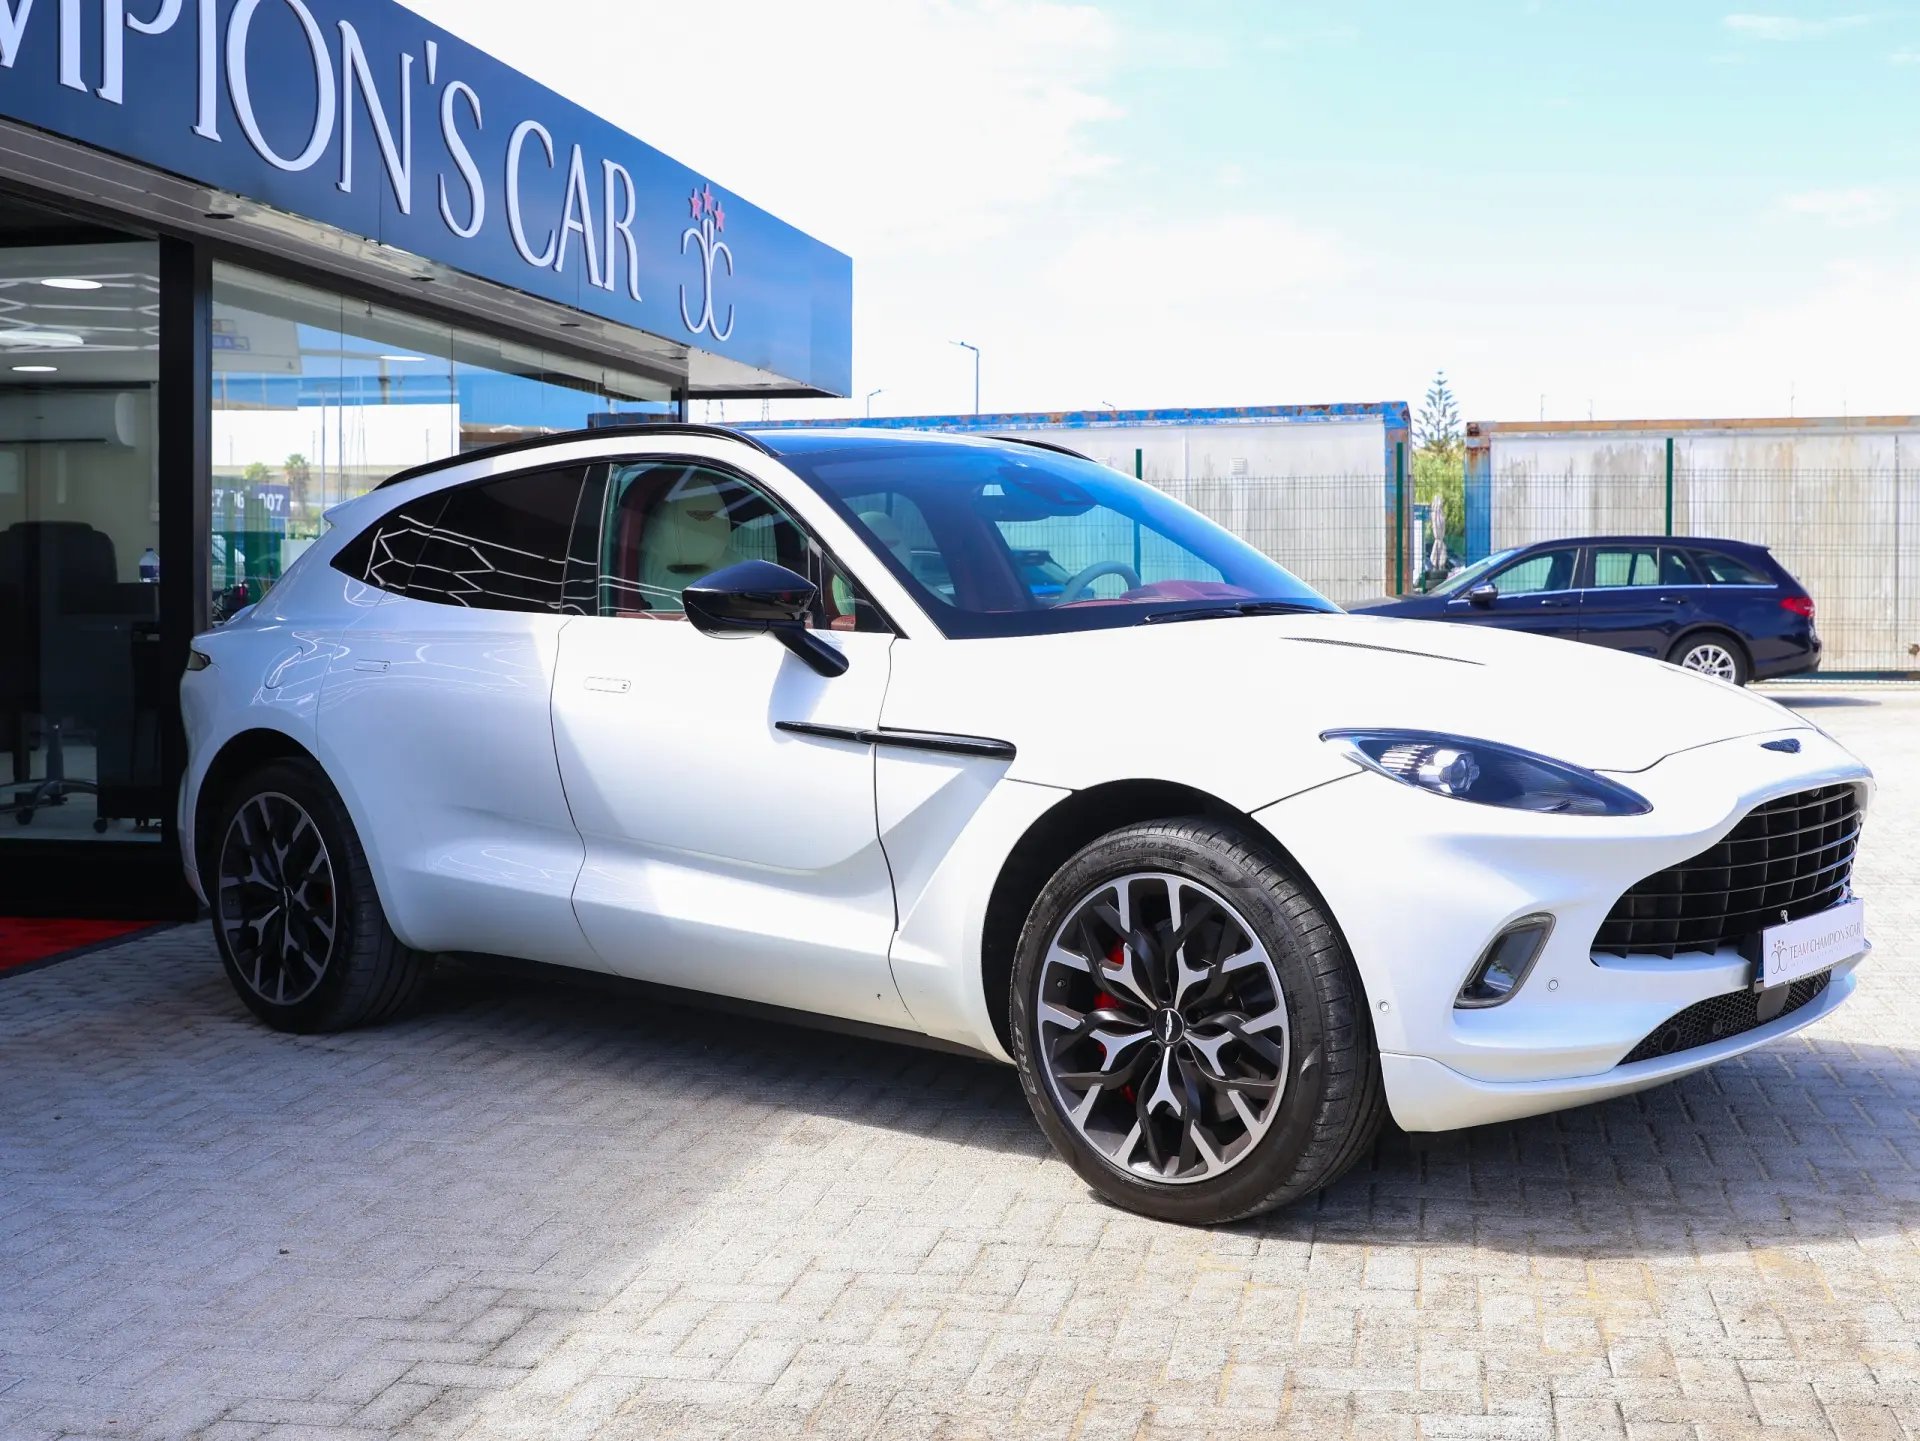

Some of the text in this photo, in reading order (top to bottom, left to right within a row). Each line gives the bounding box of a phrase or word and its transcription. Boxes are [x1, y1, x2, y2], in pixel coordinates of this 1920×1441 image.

[505, 120, 642, 302] CAR
[1789, 941, 1809, 960] TEAM
[1848, 921, 1861, 938] CAR
